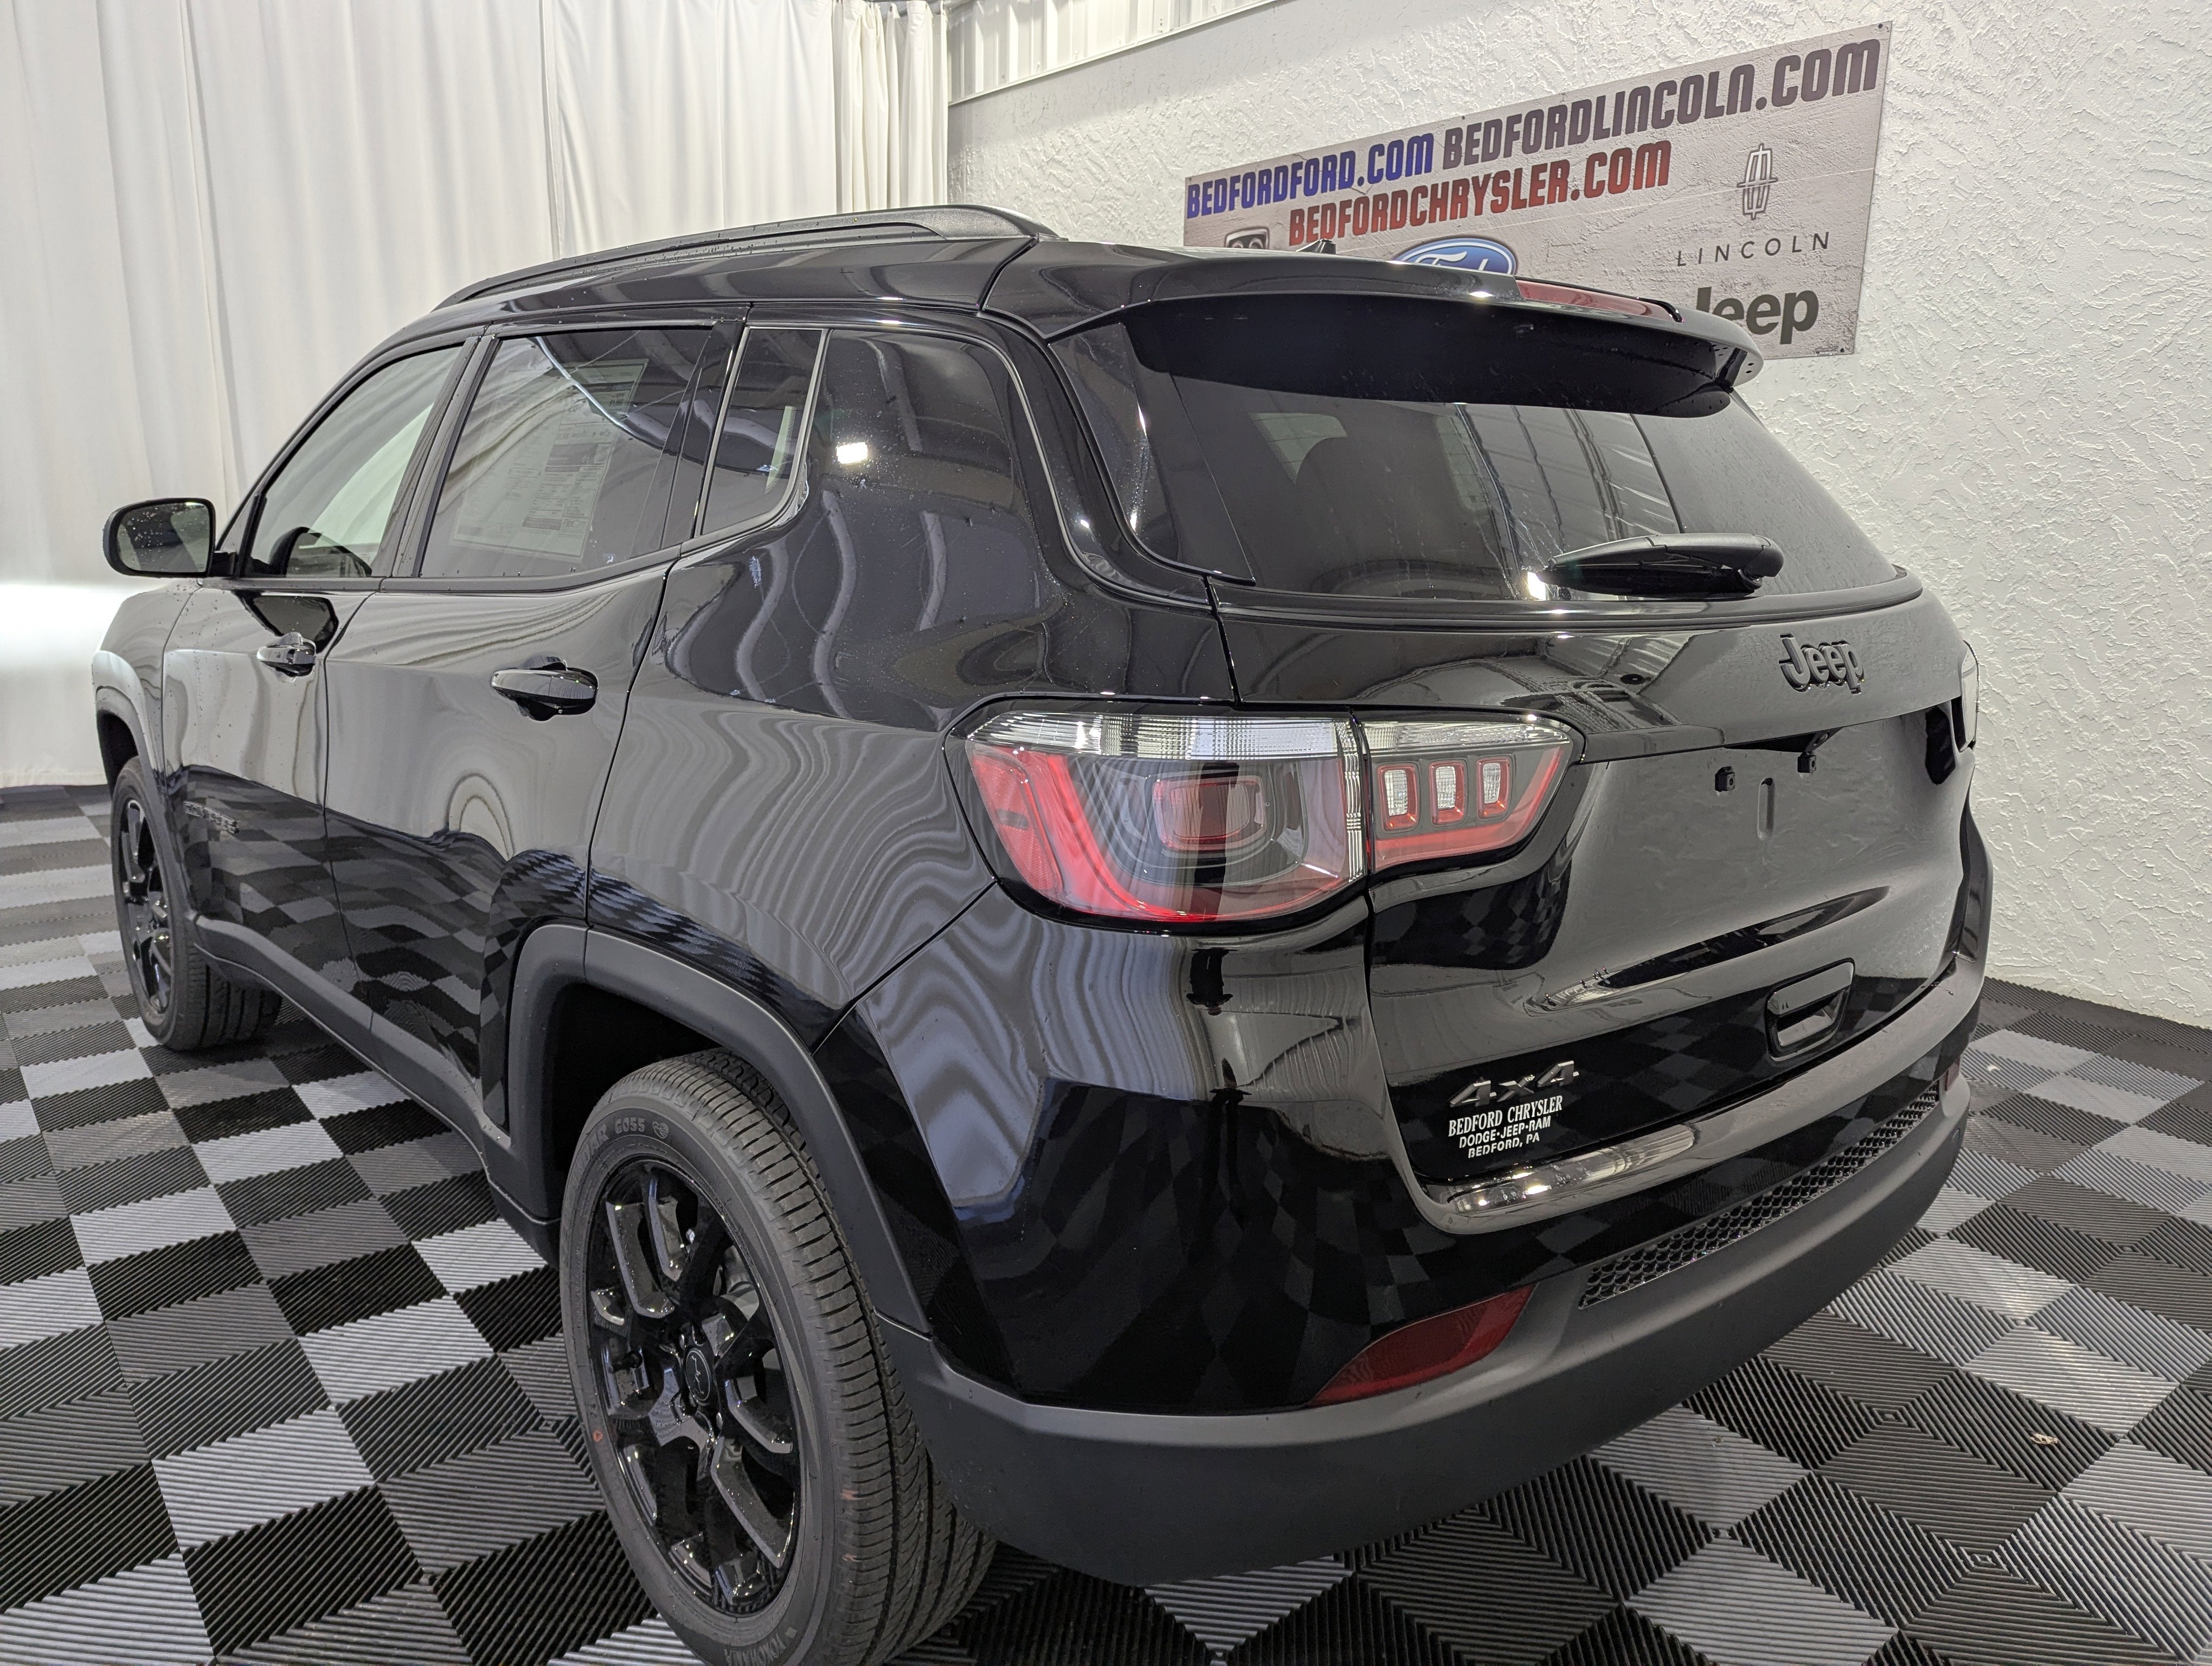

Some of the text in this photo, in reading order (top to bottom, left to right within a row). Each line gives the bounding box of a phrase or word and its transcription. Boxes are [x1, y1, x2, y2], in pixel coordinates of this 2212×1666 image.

[1187, 39, 1881, 219] BEDFORDFORD.COM BEDFORDLINCOLN.COM
[1289, 140, 1671, 246] BEDFORDCHRYSLER.COM
[1677, 232, 1829, 267] LINCOLN
[1779, 633, 1864, 695] Jeep
[1448, 1095, 1563, 1137] BEDFORD CHRYSLER
[1468, 1132, 1540, 1158] BEDFORD, PA
